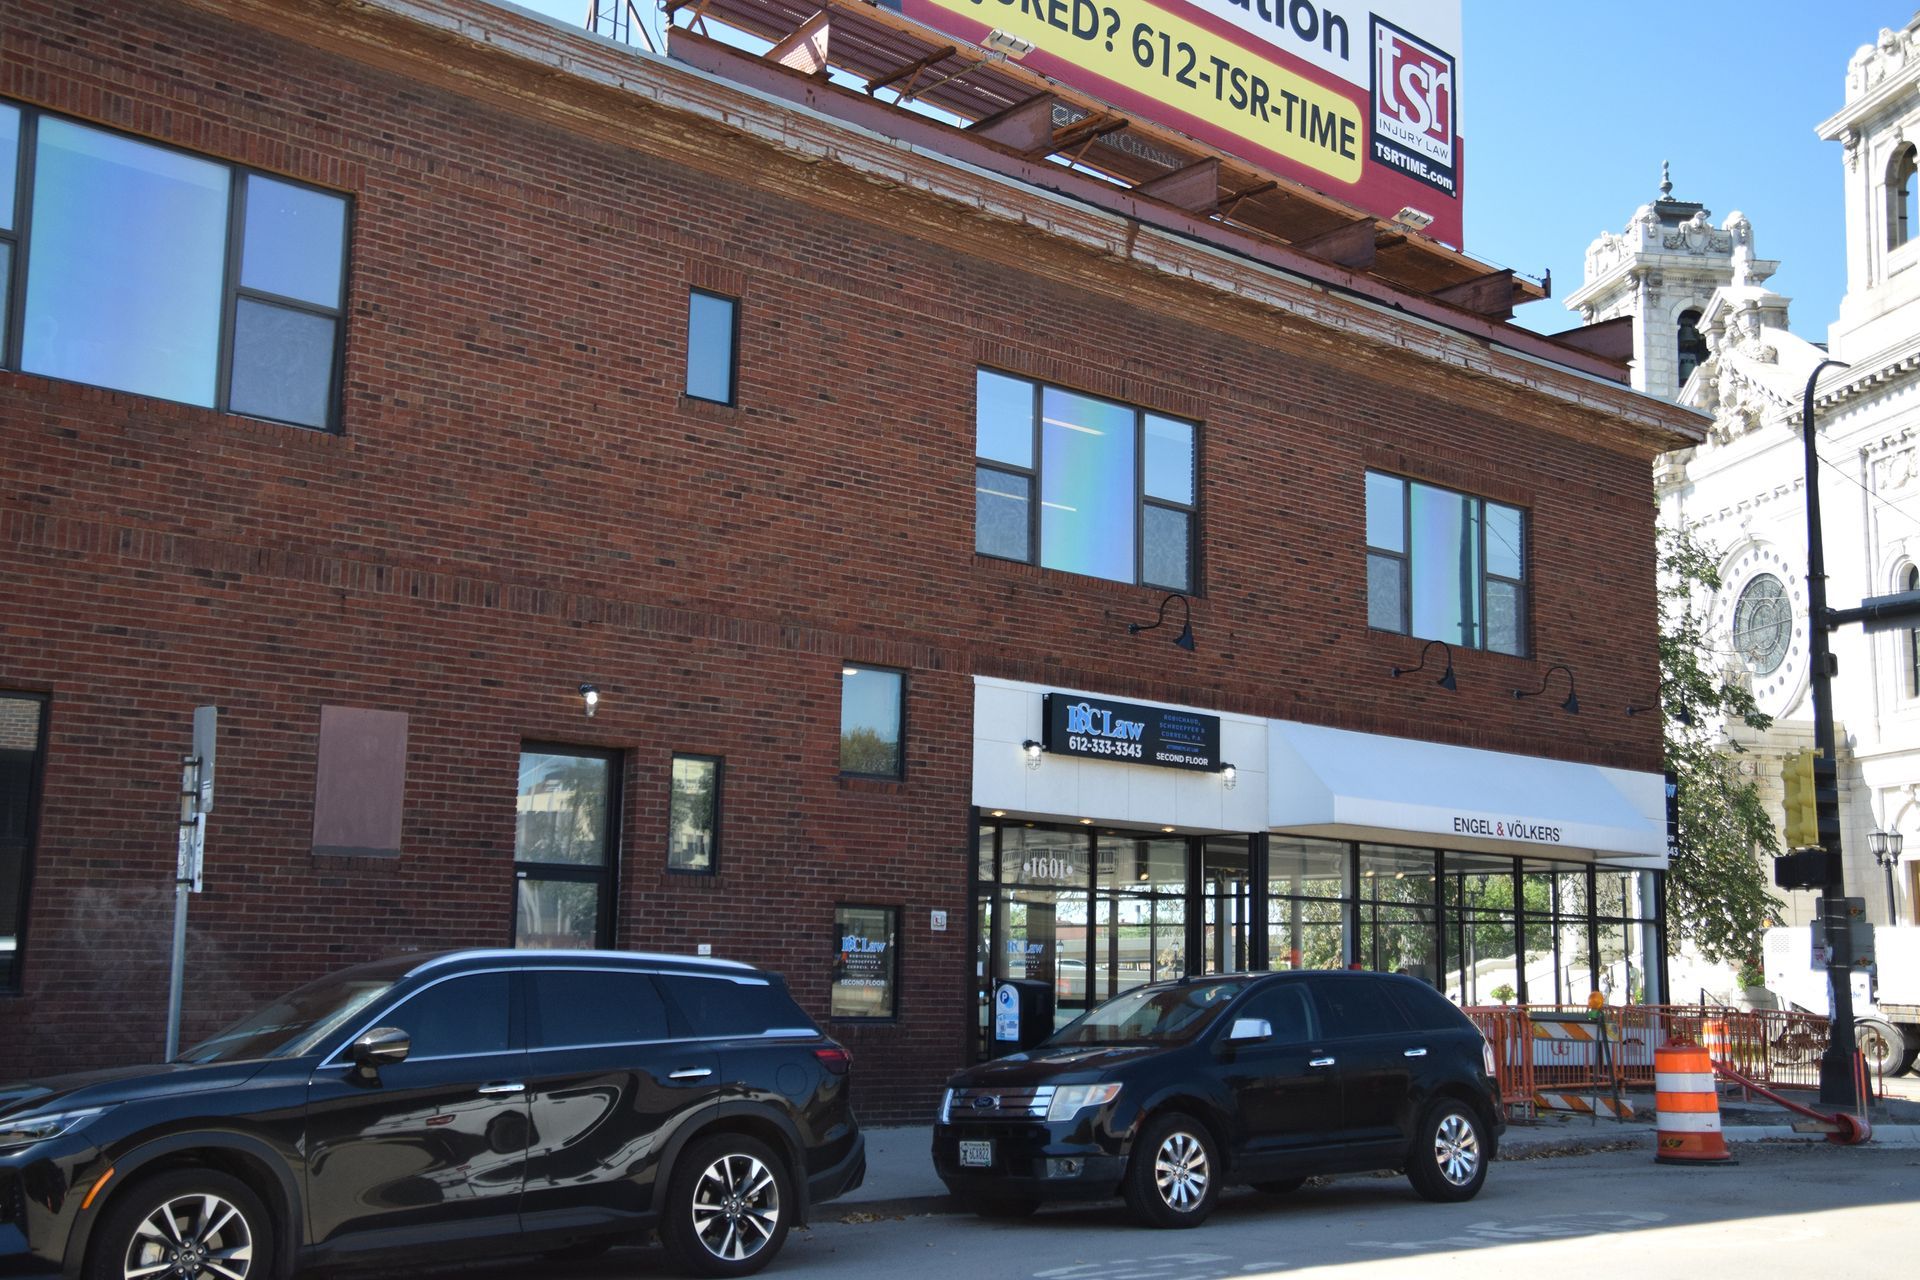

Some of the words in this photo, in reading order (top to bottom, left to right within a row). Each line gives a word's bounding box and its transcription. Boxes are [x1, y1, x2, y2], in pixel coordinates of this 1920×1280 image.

[1132, 23, 1356, 161] 612-TSR-TIME
[1378, 27, 1449, 134] tsr
[1379, 118, 1422, 147] INJURY
[1425, 141, 1449, 160] LAW
[1375, 141, 1453, 190] TSRTIME.com
[1069, 735, 1143, 758] 612-333-3343
[1156, 752, 1184, 763] SECOND
[1185, 756, 1209, 766] FLOOR
[1453, 817, 1494, 836] ENGEL
[1496, 821, 1505, 836] &
[1507, 819, 1560, 842] VÖLKERS
[1031, 857, 1064, 879] 1601
[865, 979, 886, 987] FLOOR
